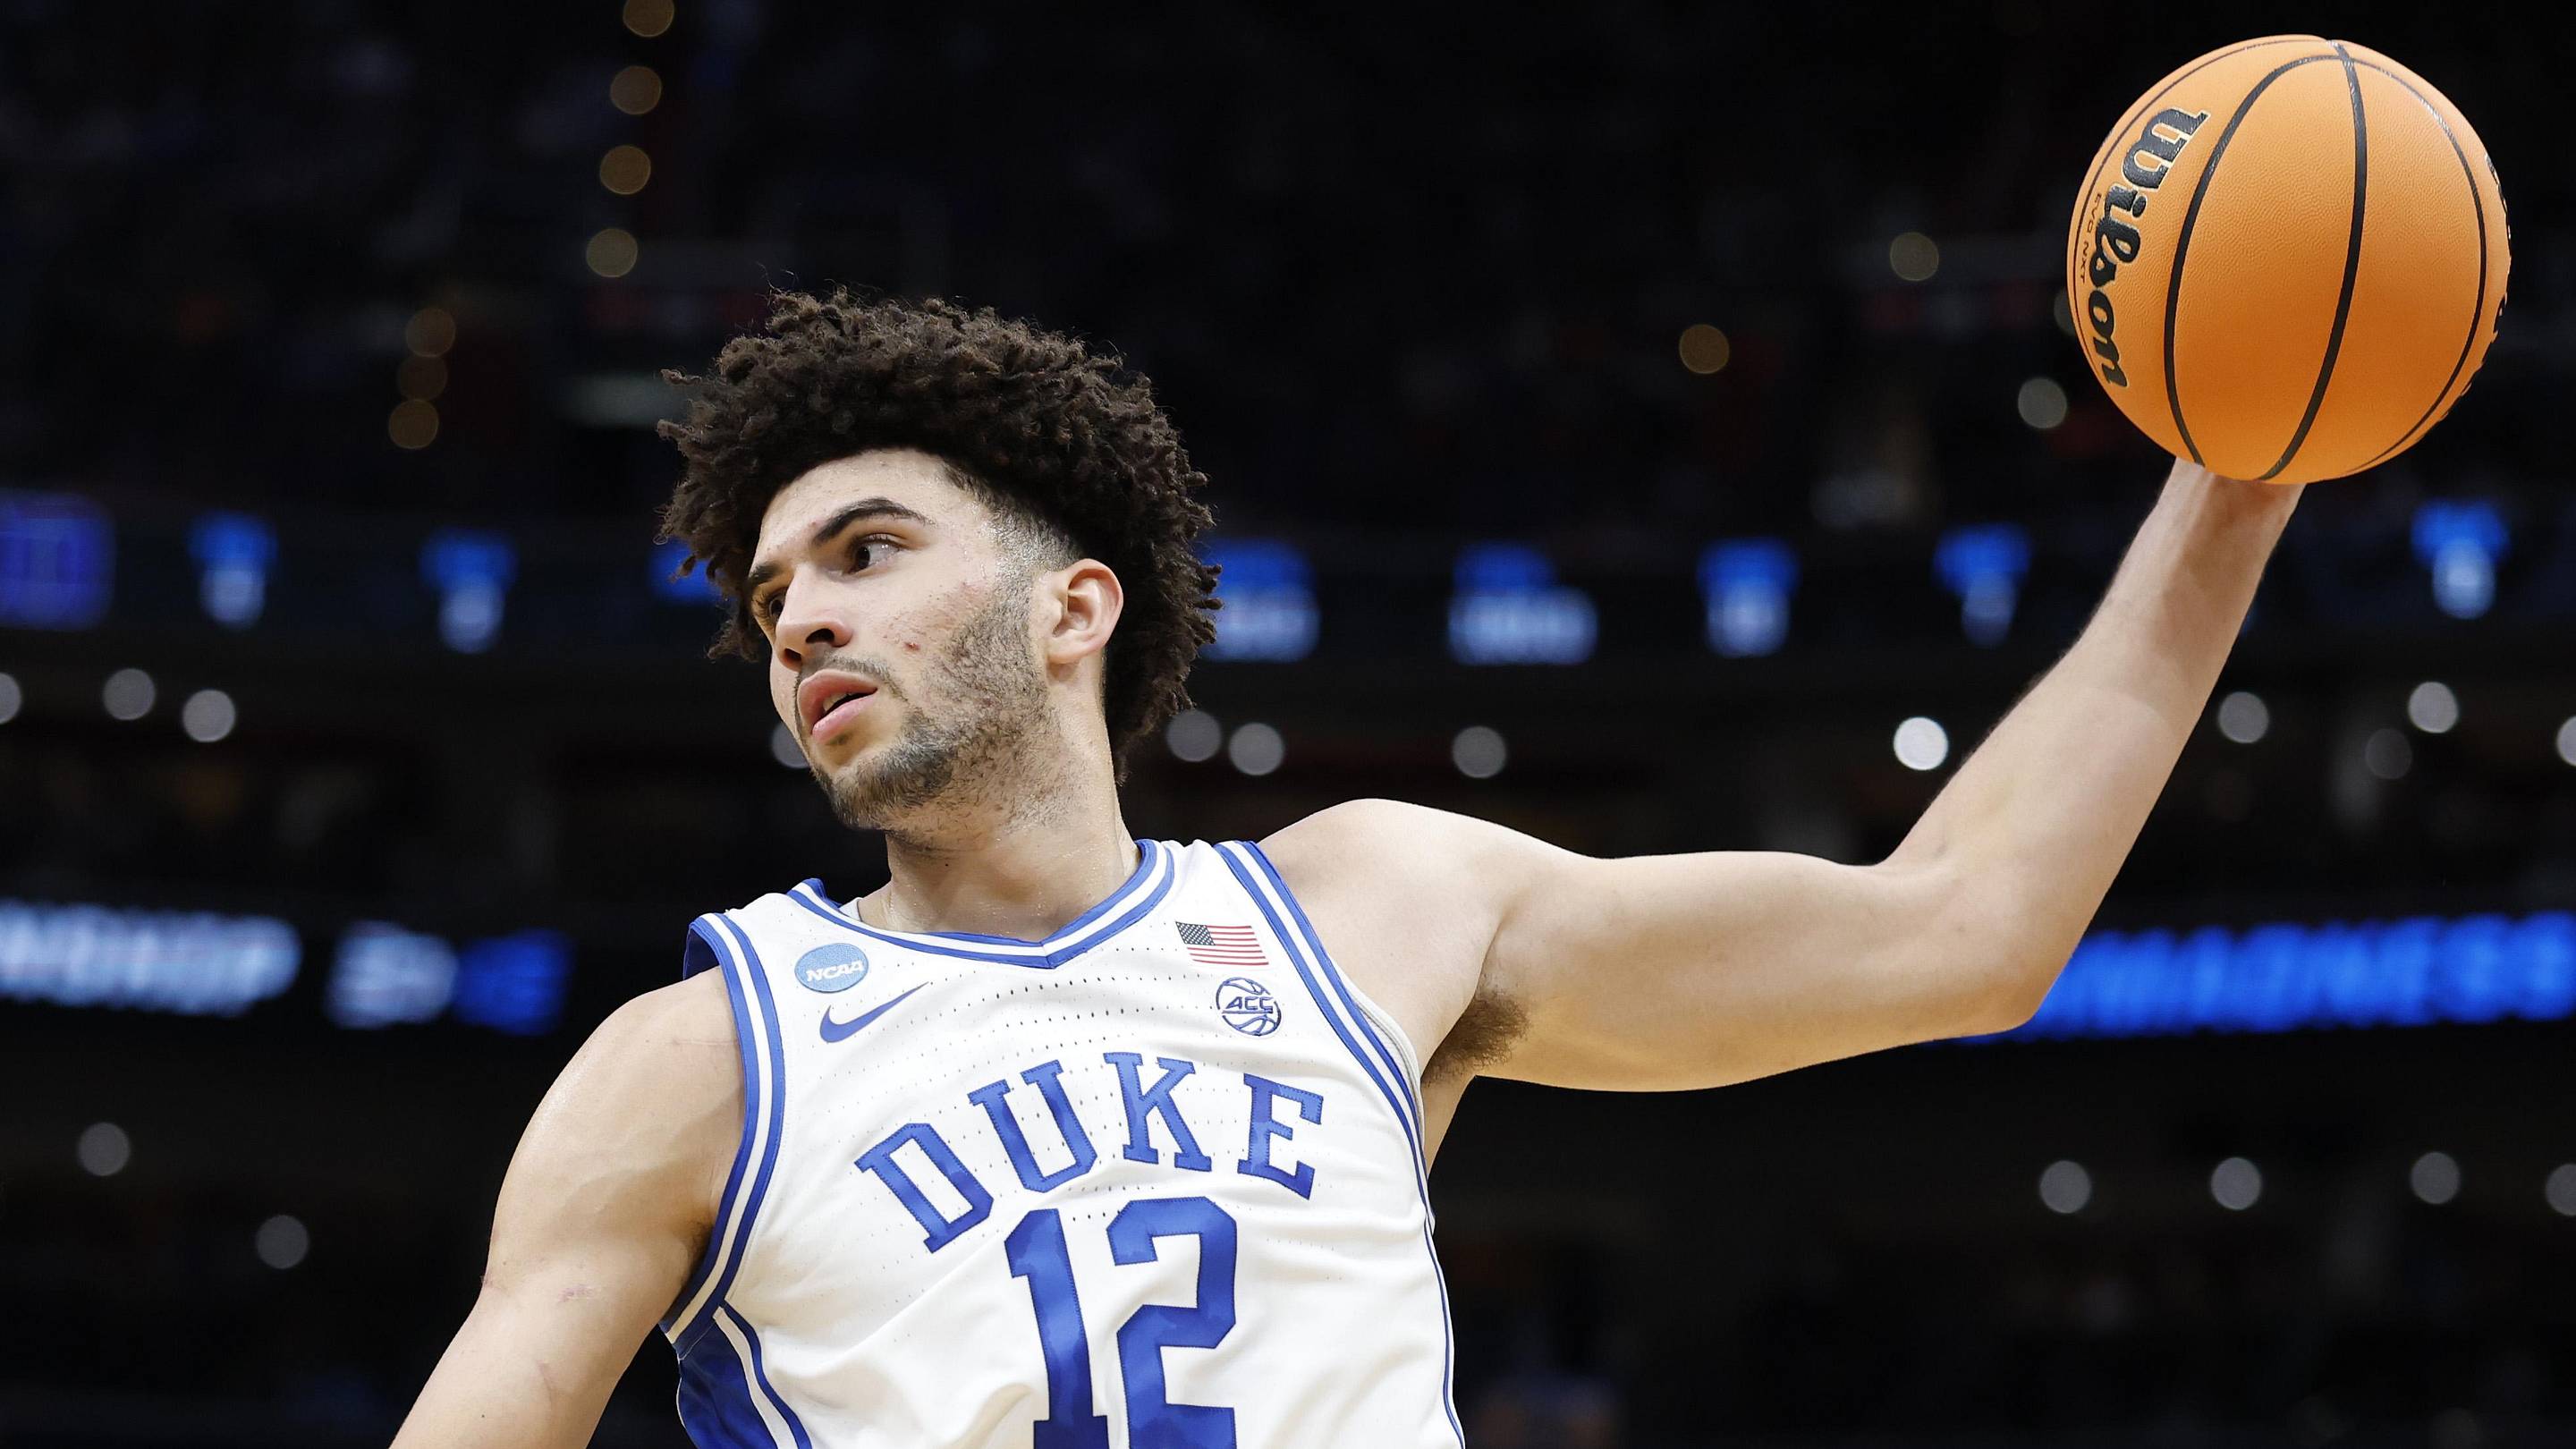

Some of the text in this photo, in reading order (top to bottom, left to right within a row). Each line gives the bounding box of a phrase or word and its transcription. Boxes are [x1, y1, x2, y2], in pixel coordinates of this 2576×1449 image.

[2080, 192, 2102, 284] EVO NXT
[2087, 106, 2211, 388] Wilson
[806, 959, 865, 982] NCAA
[1225, 996, 1274, 1013] ACC
[854, 1051, 1324, 1253] DUKE
[1004, 1196, 1237, 1449] 12
